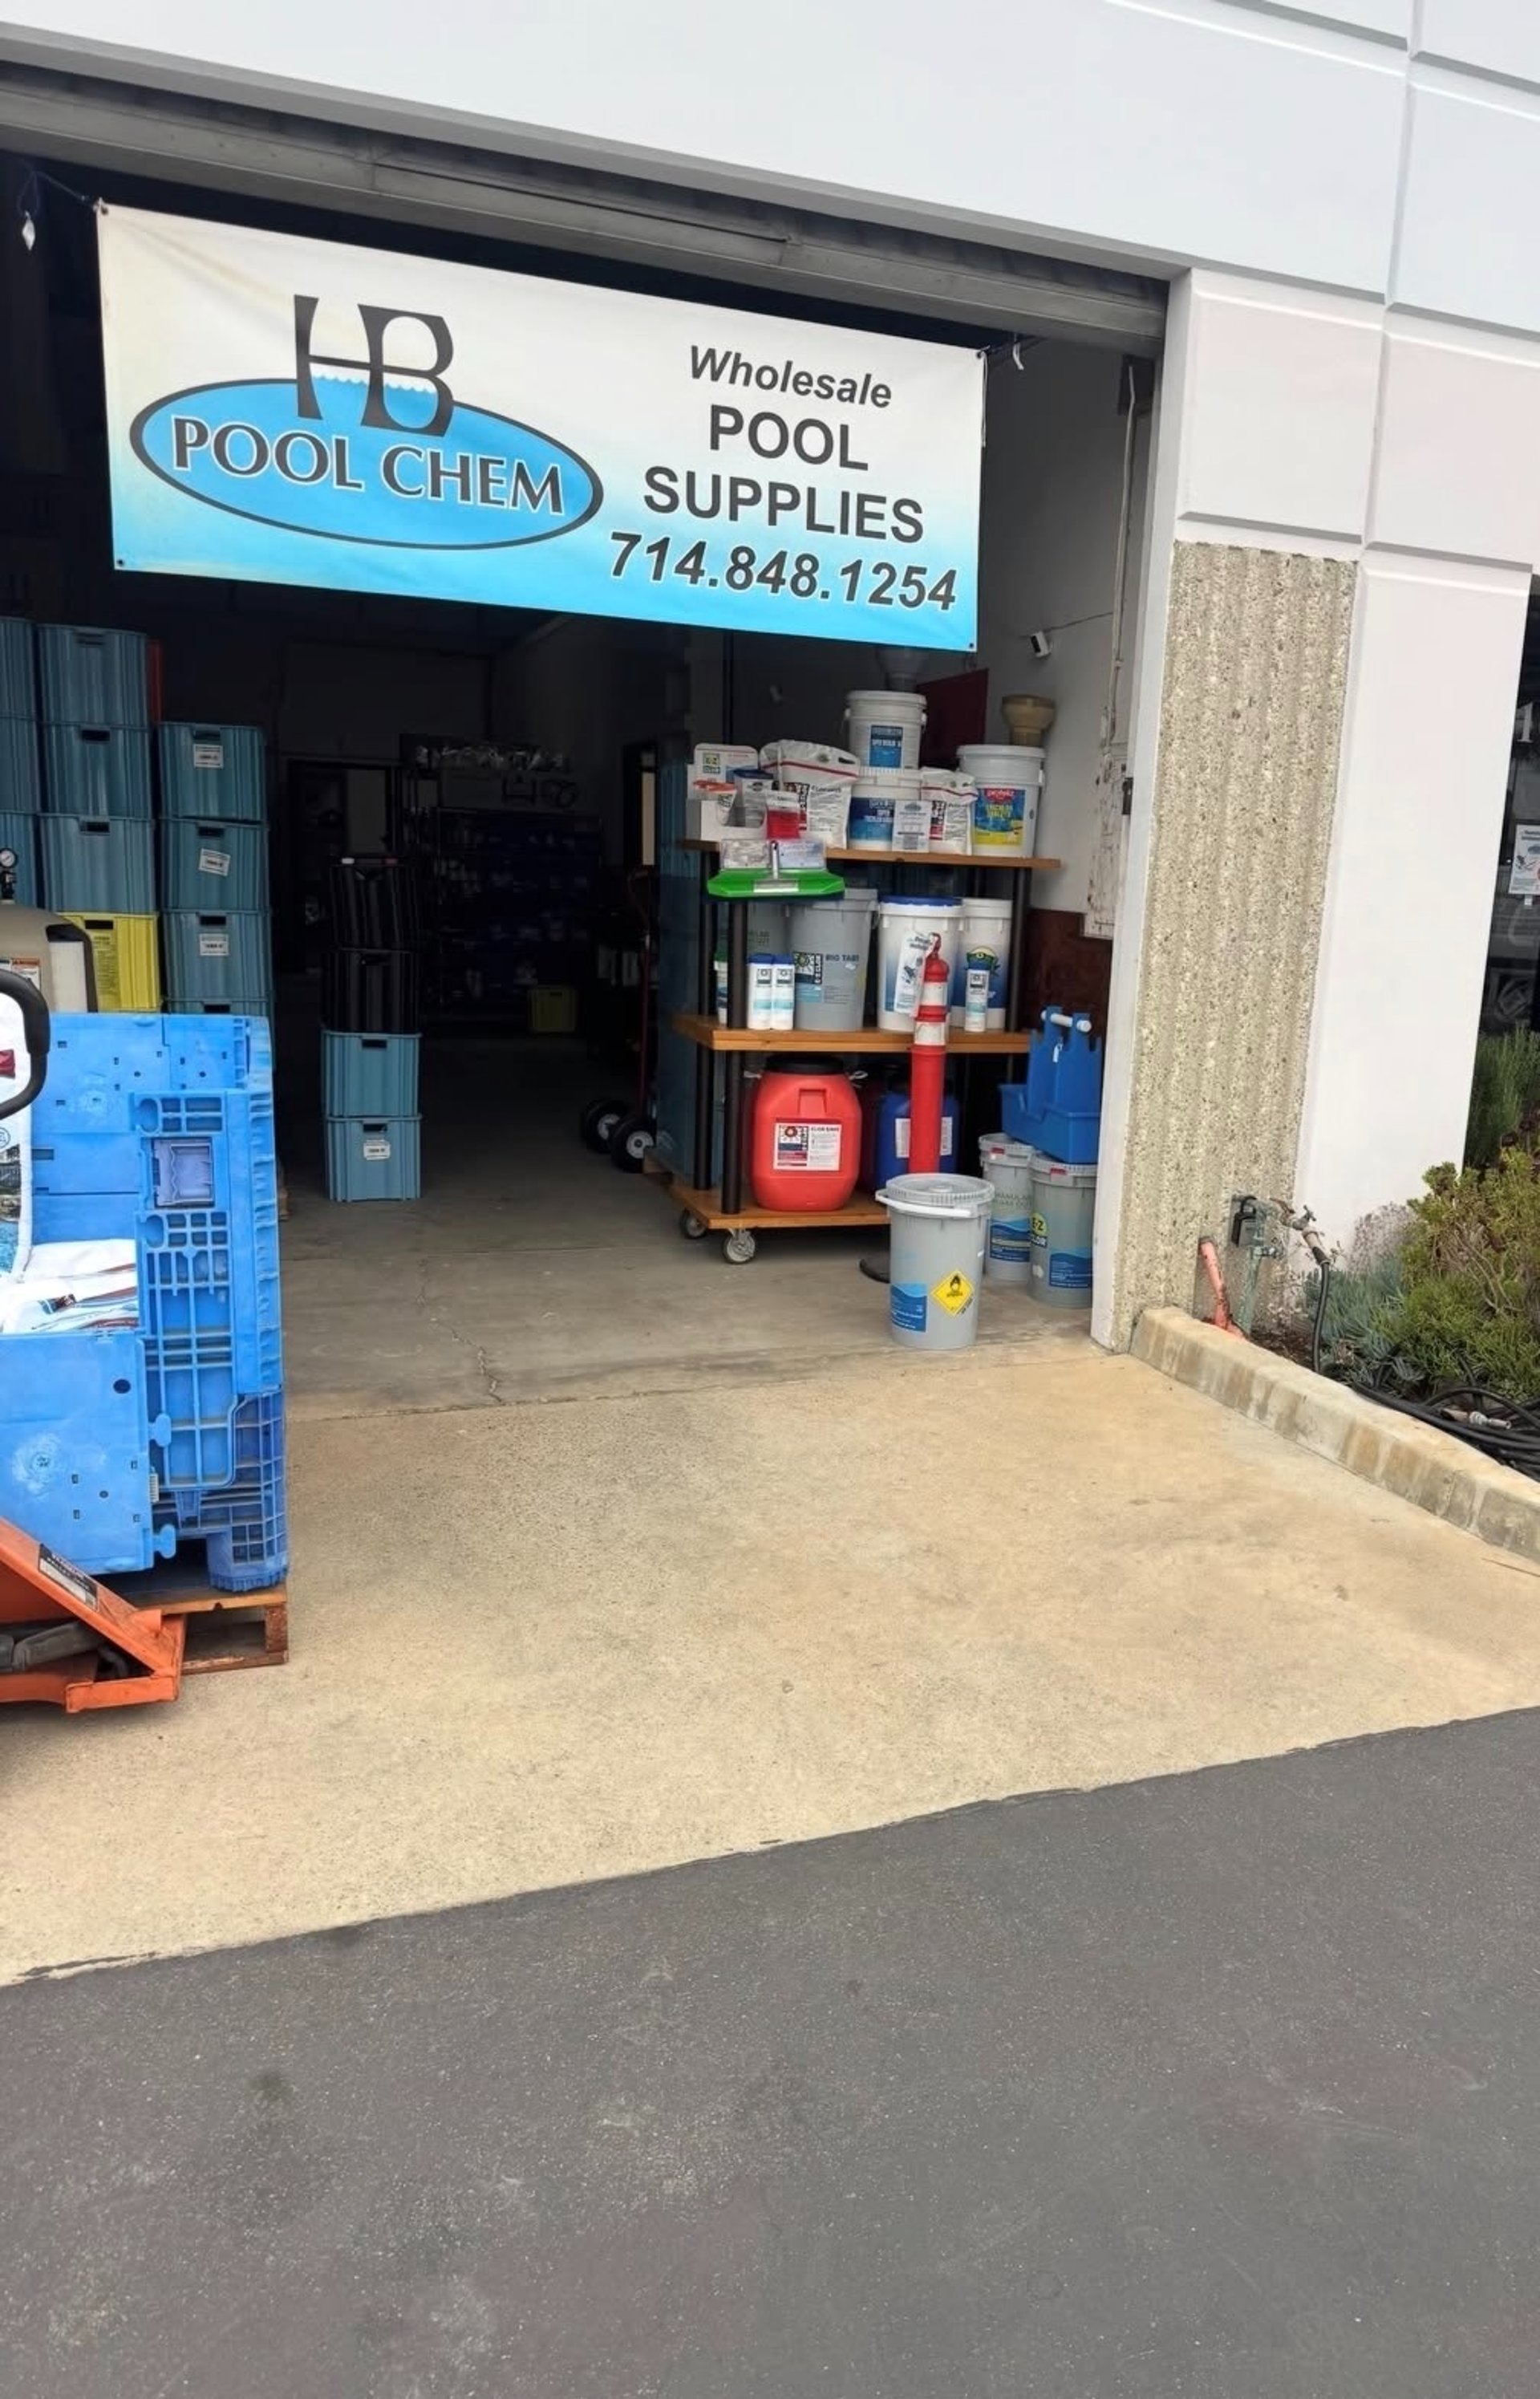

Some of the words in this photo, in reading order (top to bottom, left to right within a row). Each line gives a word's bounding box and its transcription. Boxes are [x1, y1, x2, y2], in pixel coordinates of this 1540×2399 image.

[294, 294, 454, 437] HB
[691, 345, 892, 408] Wholesale
[172, 416, 363, 491] POOL
[382, 446, 564, 514] CHEM
[710, 404, 868, 471] POOL
[643, 466, 923, 543] SUPPLIES
[610, 531, 958, 611] 714.848.1254
